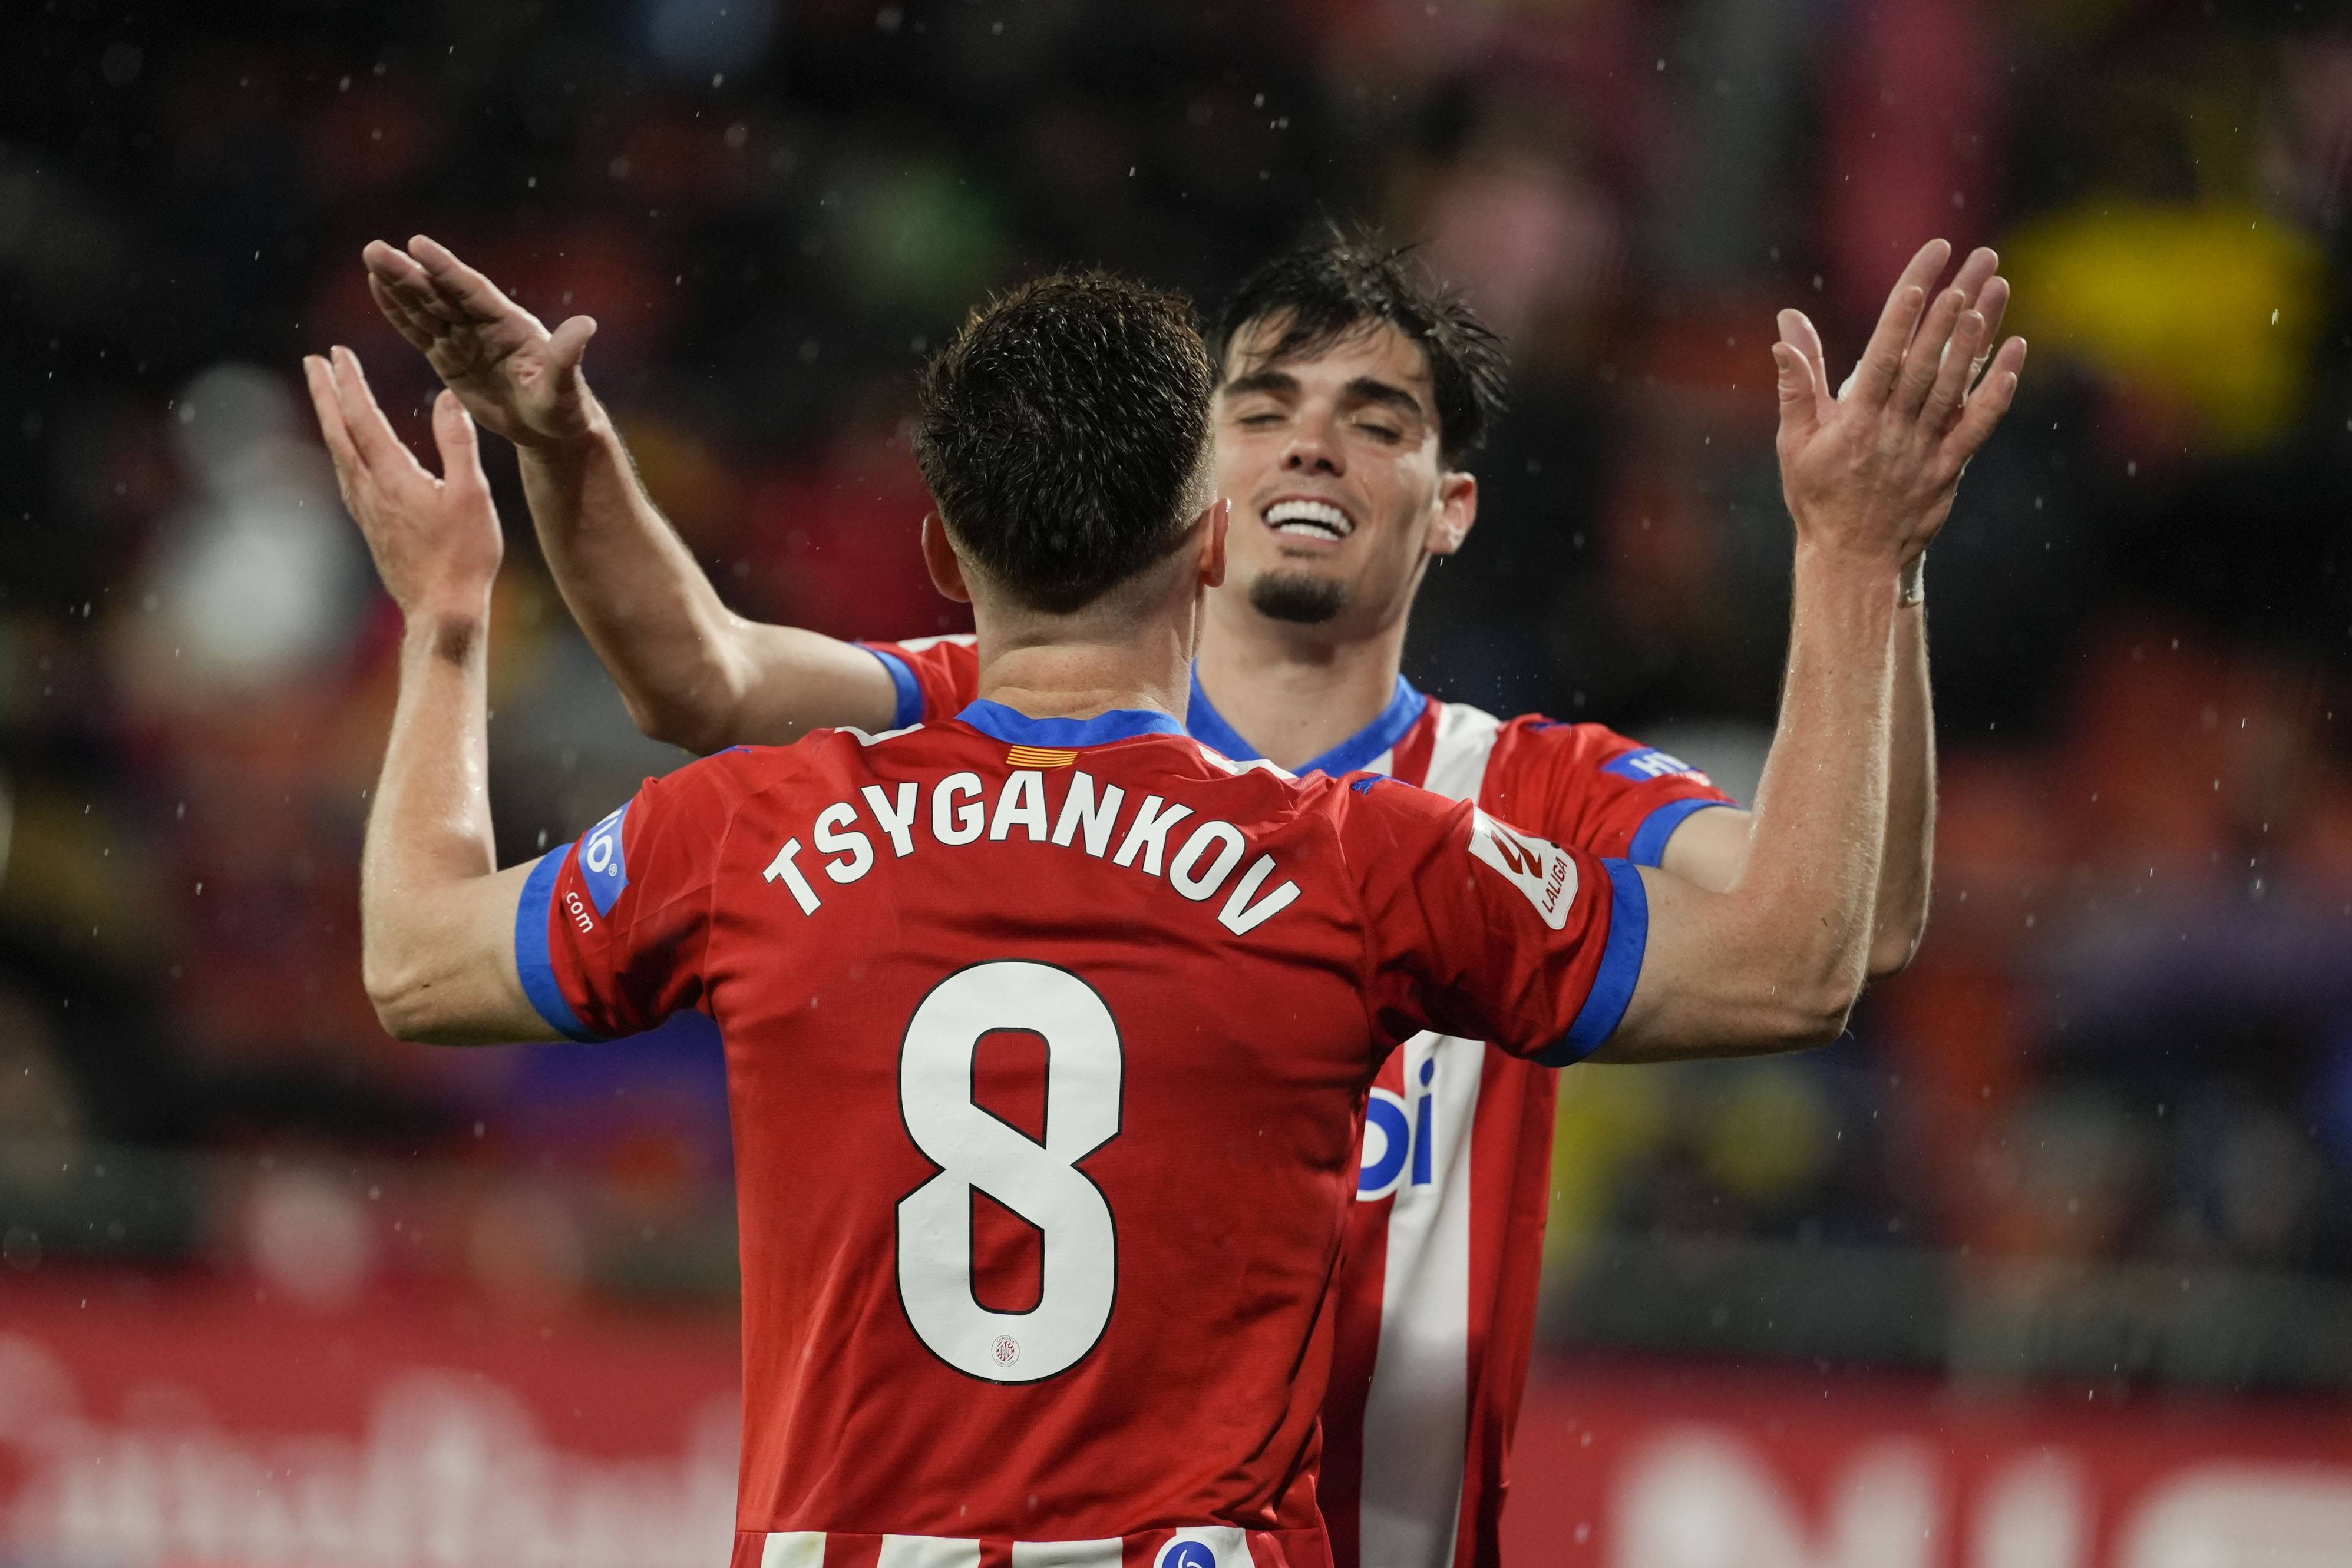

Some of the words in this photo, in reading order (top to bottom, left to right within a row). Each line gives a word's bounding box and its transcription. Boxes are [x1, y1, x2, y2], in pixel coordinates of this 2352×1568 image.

[761, 770, 1301, 937] TSYGANKOV
[1541, 856, 1568, 914] LALIGA
[894, 958, 1126, 1386] 8
[996, 1336, 1015, 1344] GIRONA
